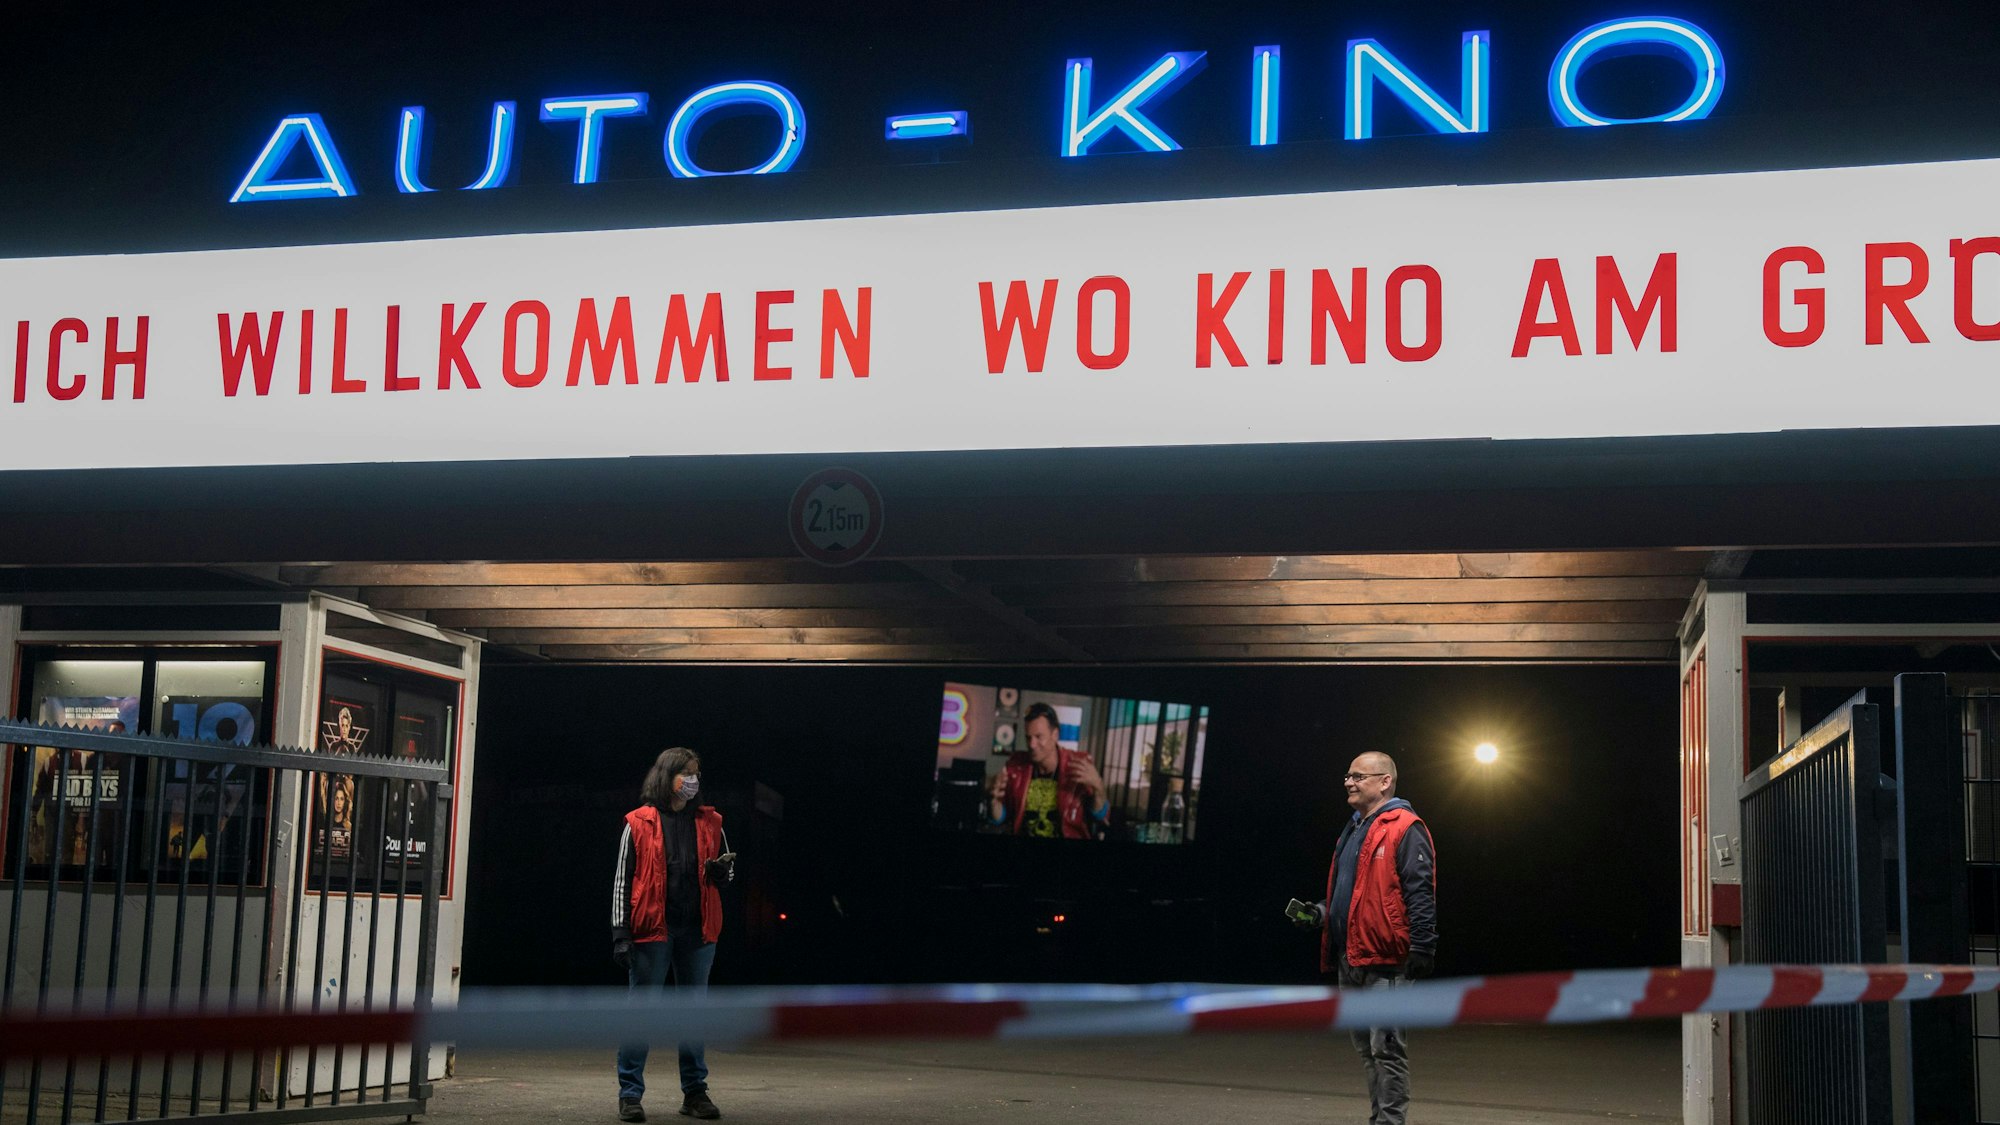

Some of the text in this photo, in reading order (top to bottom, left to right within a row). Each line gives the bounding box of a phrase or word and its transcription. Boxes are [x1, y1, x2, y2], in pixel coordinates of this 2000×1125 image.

[228, 78, 807, 203] AUTO
[1058, 13, 1727, 160] KINO
[14, 315, 149, 403] ICH
[218, 286, 873, 398] WILLKOMMEN
[977, 275, 1131, 375] WO
[1195, 264, 1443, 369] KINO
[1510, 252, 1678, 359] AM
[82, 779, 119, 797] BYS
[71, 797, 84, 807] FOR
[386, 836, 426, 853] Coudwn
